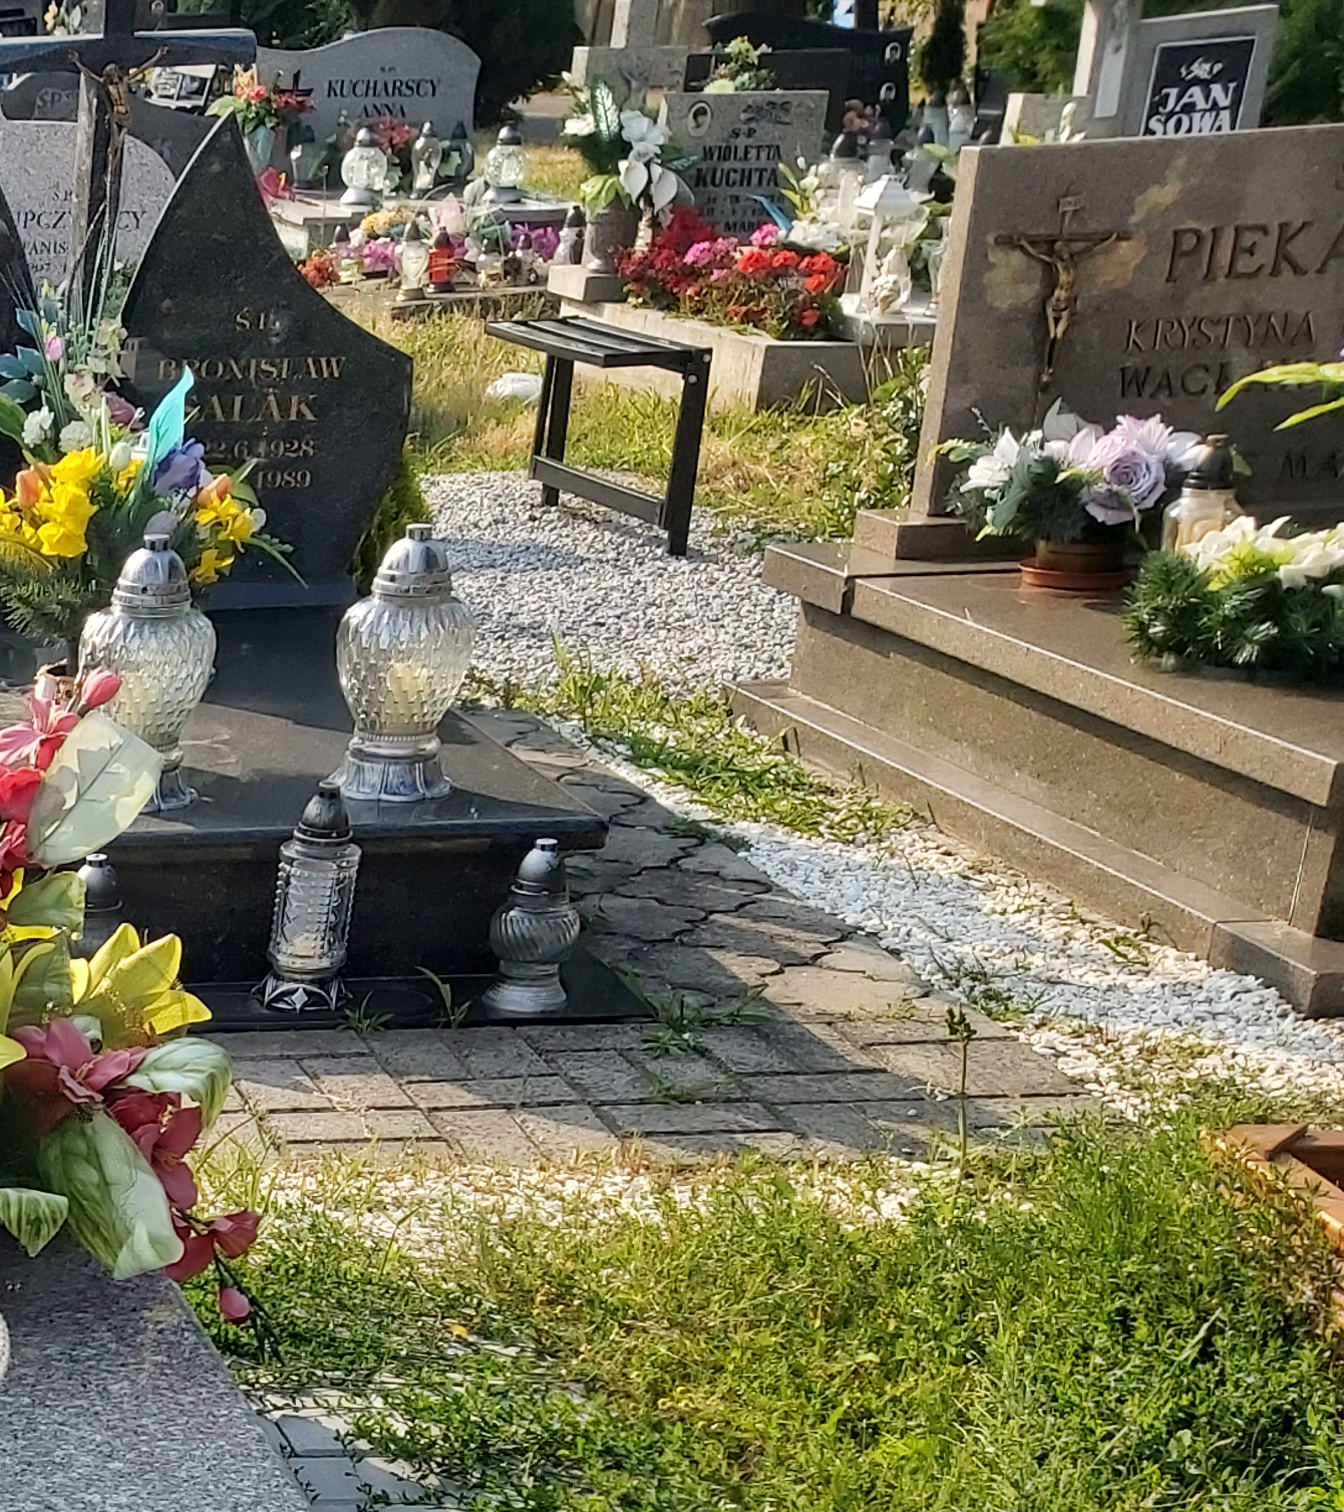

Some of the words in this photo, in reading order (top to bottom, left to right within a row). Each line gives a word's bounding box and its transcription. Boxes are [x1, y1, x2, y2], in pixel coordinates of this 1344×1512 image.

[327, 78, 440, 98] KUCHARSCY
[1153, 82, 1237, 113] JAN
[361, 103, 407, 118] ANNA
[1148, 109, 1232, 137] SOWA
[702, 144, 782, 161] WIOLETTA
[694, 167, 780, 188] KUCHTA
[1125, 310, 1317, 352] KRYSTYNA
